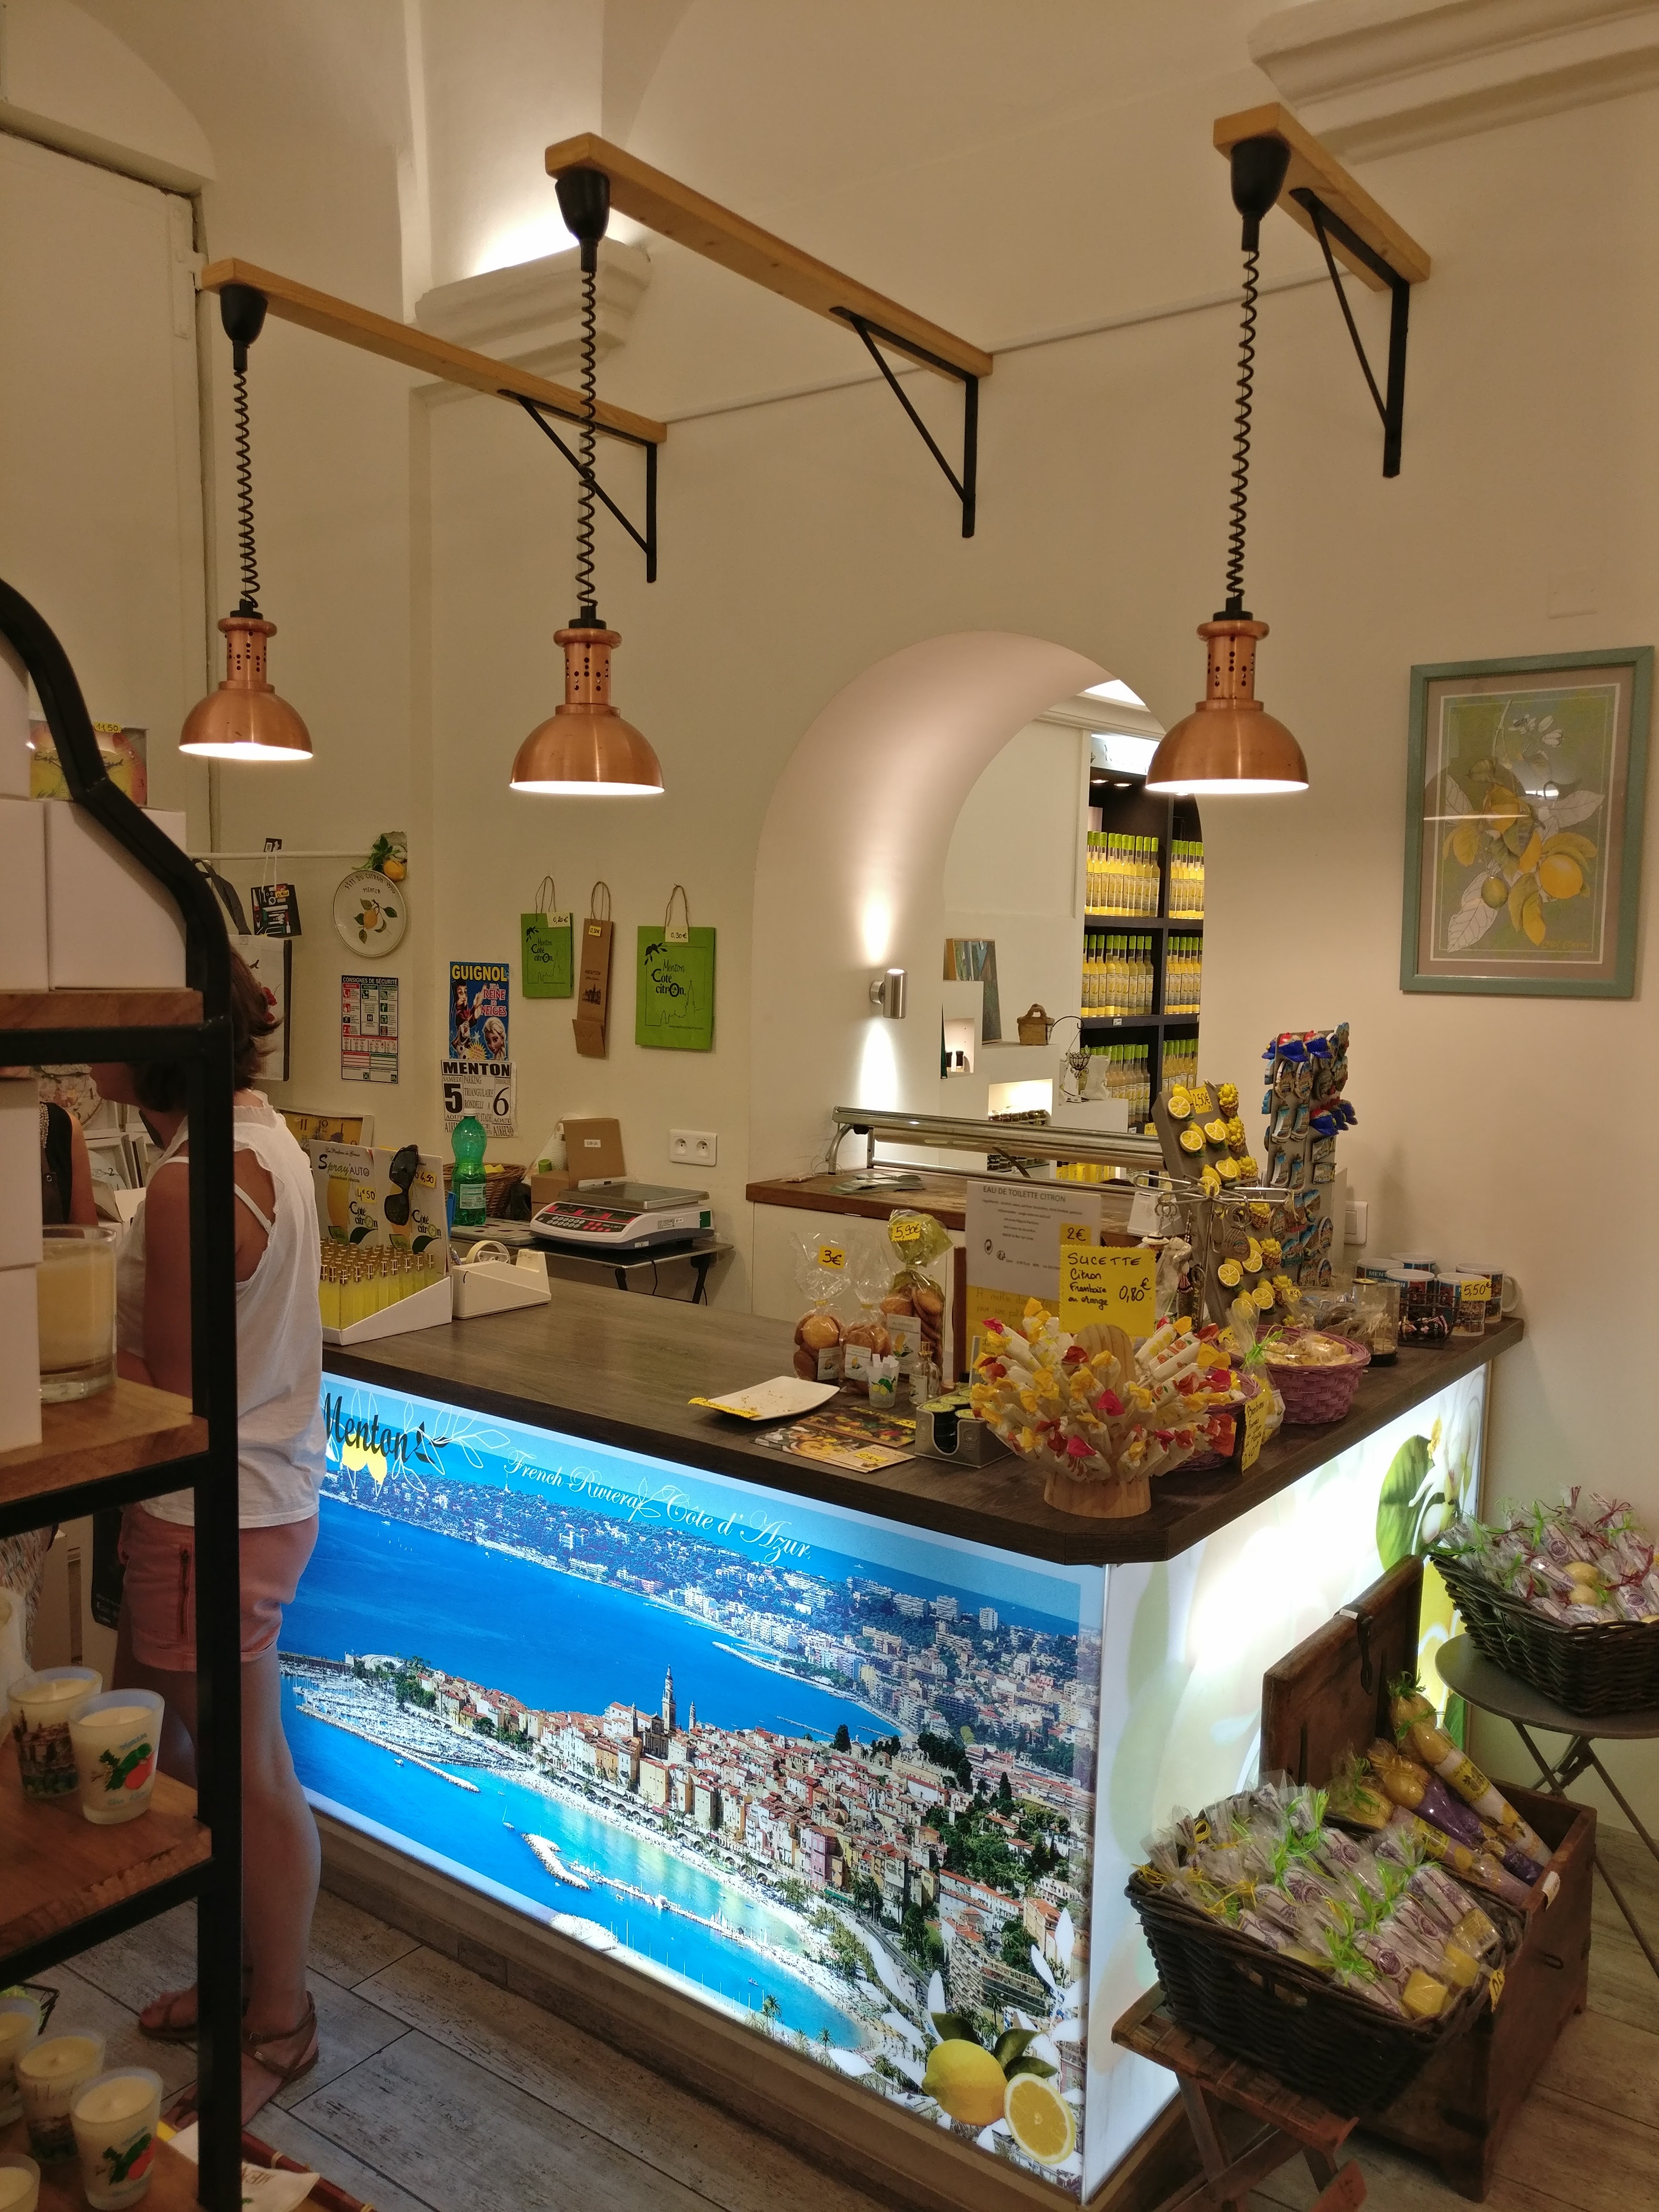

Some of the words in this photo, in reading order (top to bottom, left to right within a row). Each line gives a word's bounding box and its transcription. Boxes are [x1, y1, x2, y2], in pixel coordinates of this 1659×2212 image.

[366, 873, 383, 883] CITRON
[553, 916, 569, 924] 0,20€
[537, 937, 553, 946] Menton
[663, 959, 685, 972] Menton
[452, 964, 508, 982] GUIGNOL
[483, 989, 506, 1001] REINE
[481, 1005, 507, 1017] NEIGES
[443, 1062, 510, 1076] MENTON
[464, 1075, 481, 1084] PARKING
[444, 1083, 463, 1114] 5
[464, 1087, 493, 1097] TRIANGULAIRE
[464, 1100, 484, 1109] RONDELLI
[493, 1086, 510, 1116] 6
[300, 1118, 308, 1131] 11
[318, 1120, 329, 1133] 12
[493, 1125, 514, 1137] A18H30
[420, 1171, 434, 1183] 4,50
[983, 1186, 997, 1194] EAU
[1009, 1189, 1038, 1199] TOILETTE
[1040, 1194, 1066, 1202] CITRON
[894, 1224, 922, 1239] 5,90€
[1066, 1227, 1086, 1241] 2€
[822, 1249, 842, 1266] 3€
[1067, 1252, 1142, 1266] SUCETTE
[1070, 1268, 1102, 1280] Citron
[1368, 1270, 1388, 1279] MENT
[1069, 1281, 1107, 1293] Framboise
[1464, 1282, 1492, 1298] 5,50€
[1081, 1296, 1109, 1311] orange
[324, 1393, 410, 1463] Menton
[503, 1446, 564, 1487] French
[565, 1466, 641, 1511] Riviera
[666, 1492, 714, 1530] Côte
